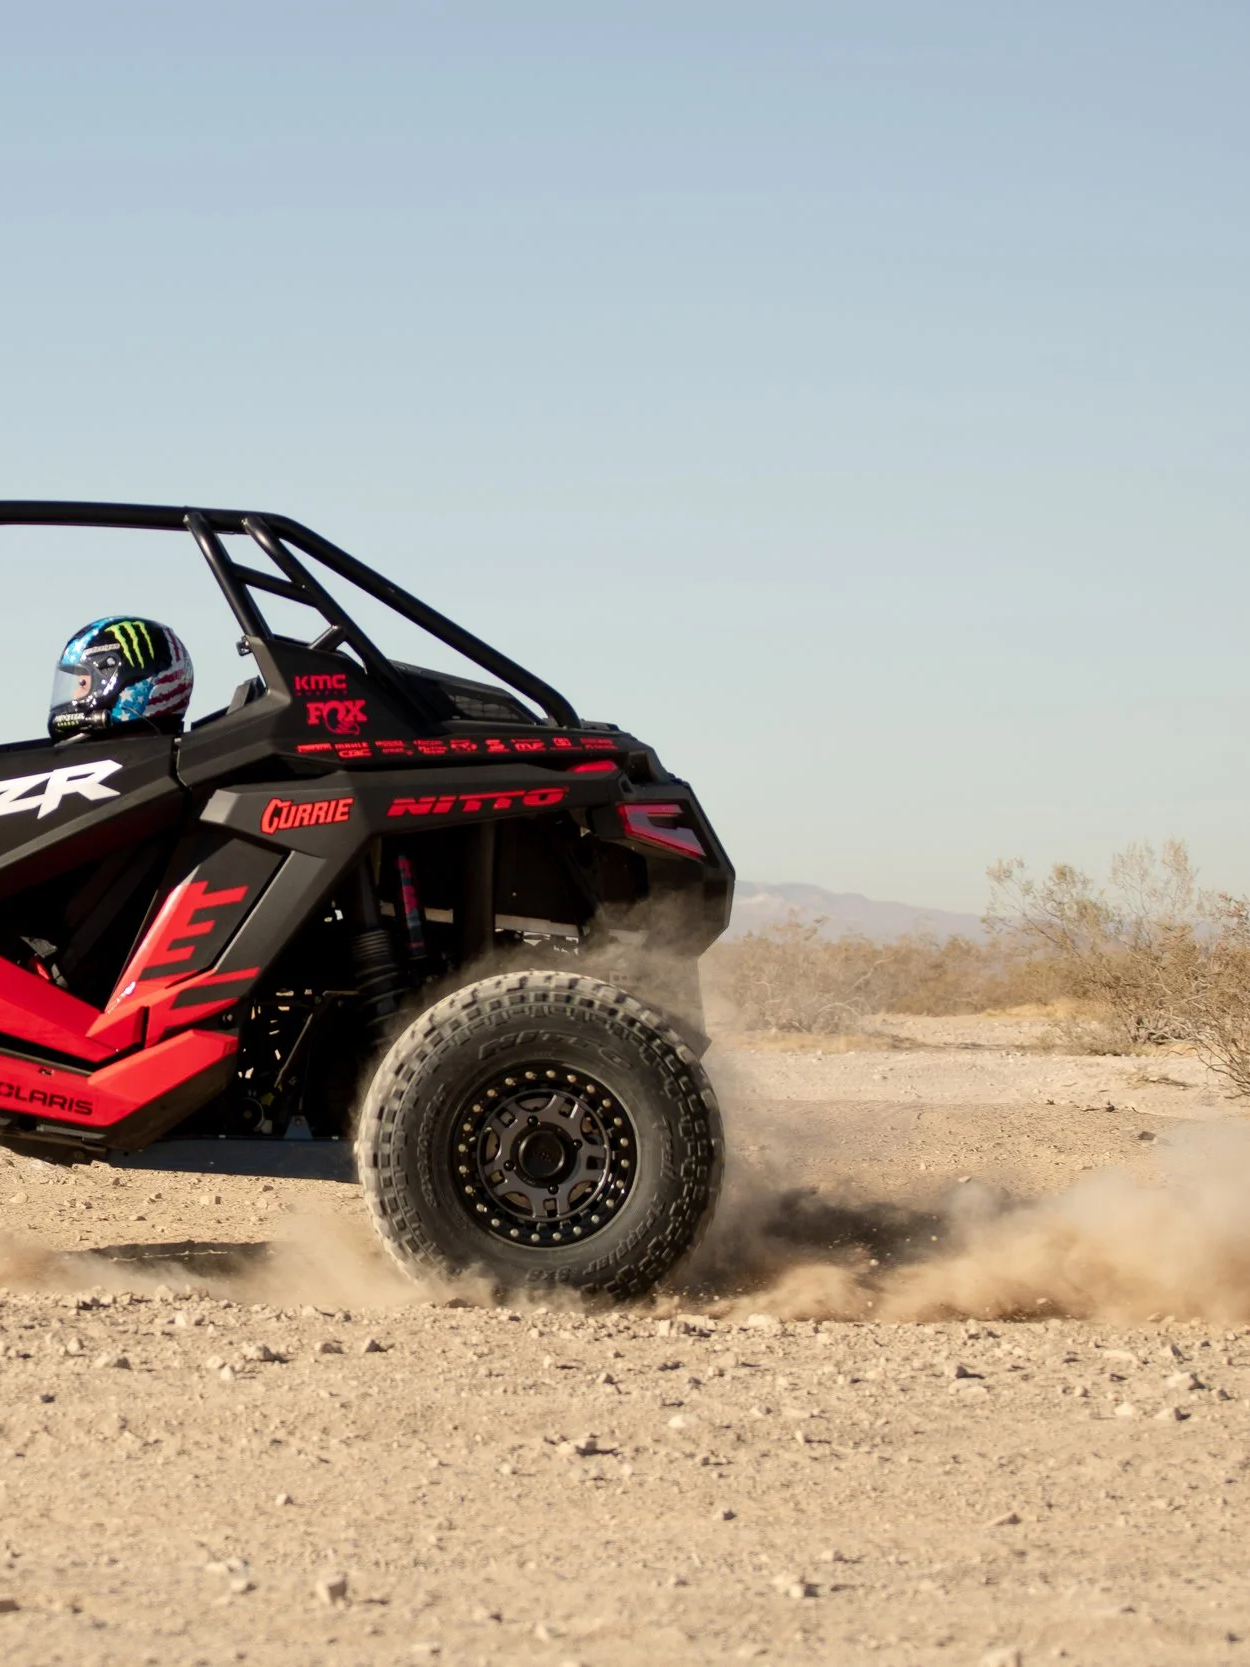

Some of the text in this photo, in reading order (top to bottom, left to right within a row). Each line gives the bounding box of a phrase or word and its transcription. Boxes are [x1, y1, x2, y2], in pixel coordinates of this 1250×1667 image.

[294, 673, 347, 691] KMC
[306, 699, 369, 735] FOX
[261, 797, 355, 835] CURRIE
[386, 787, 567, 817] NITTO
